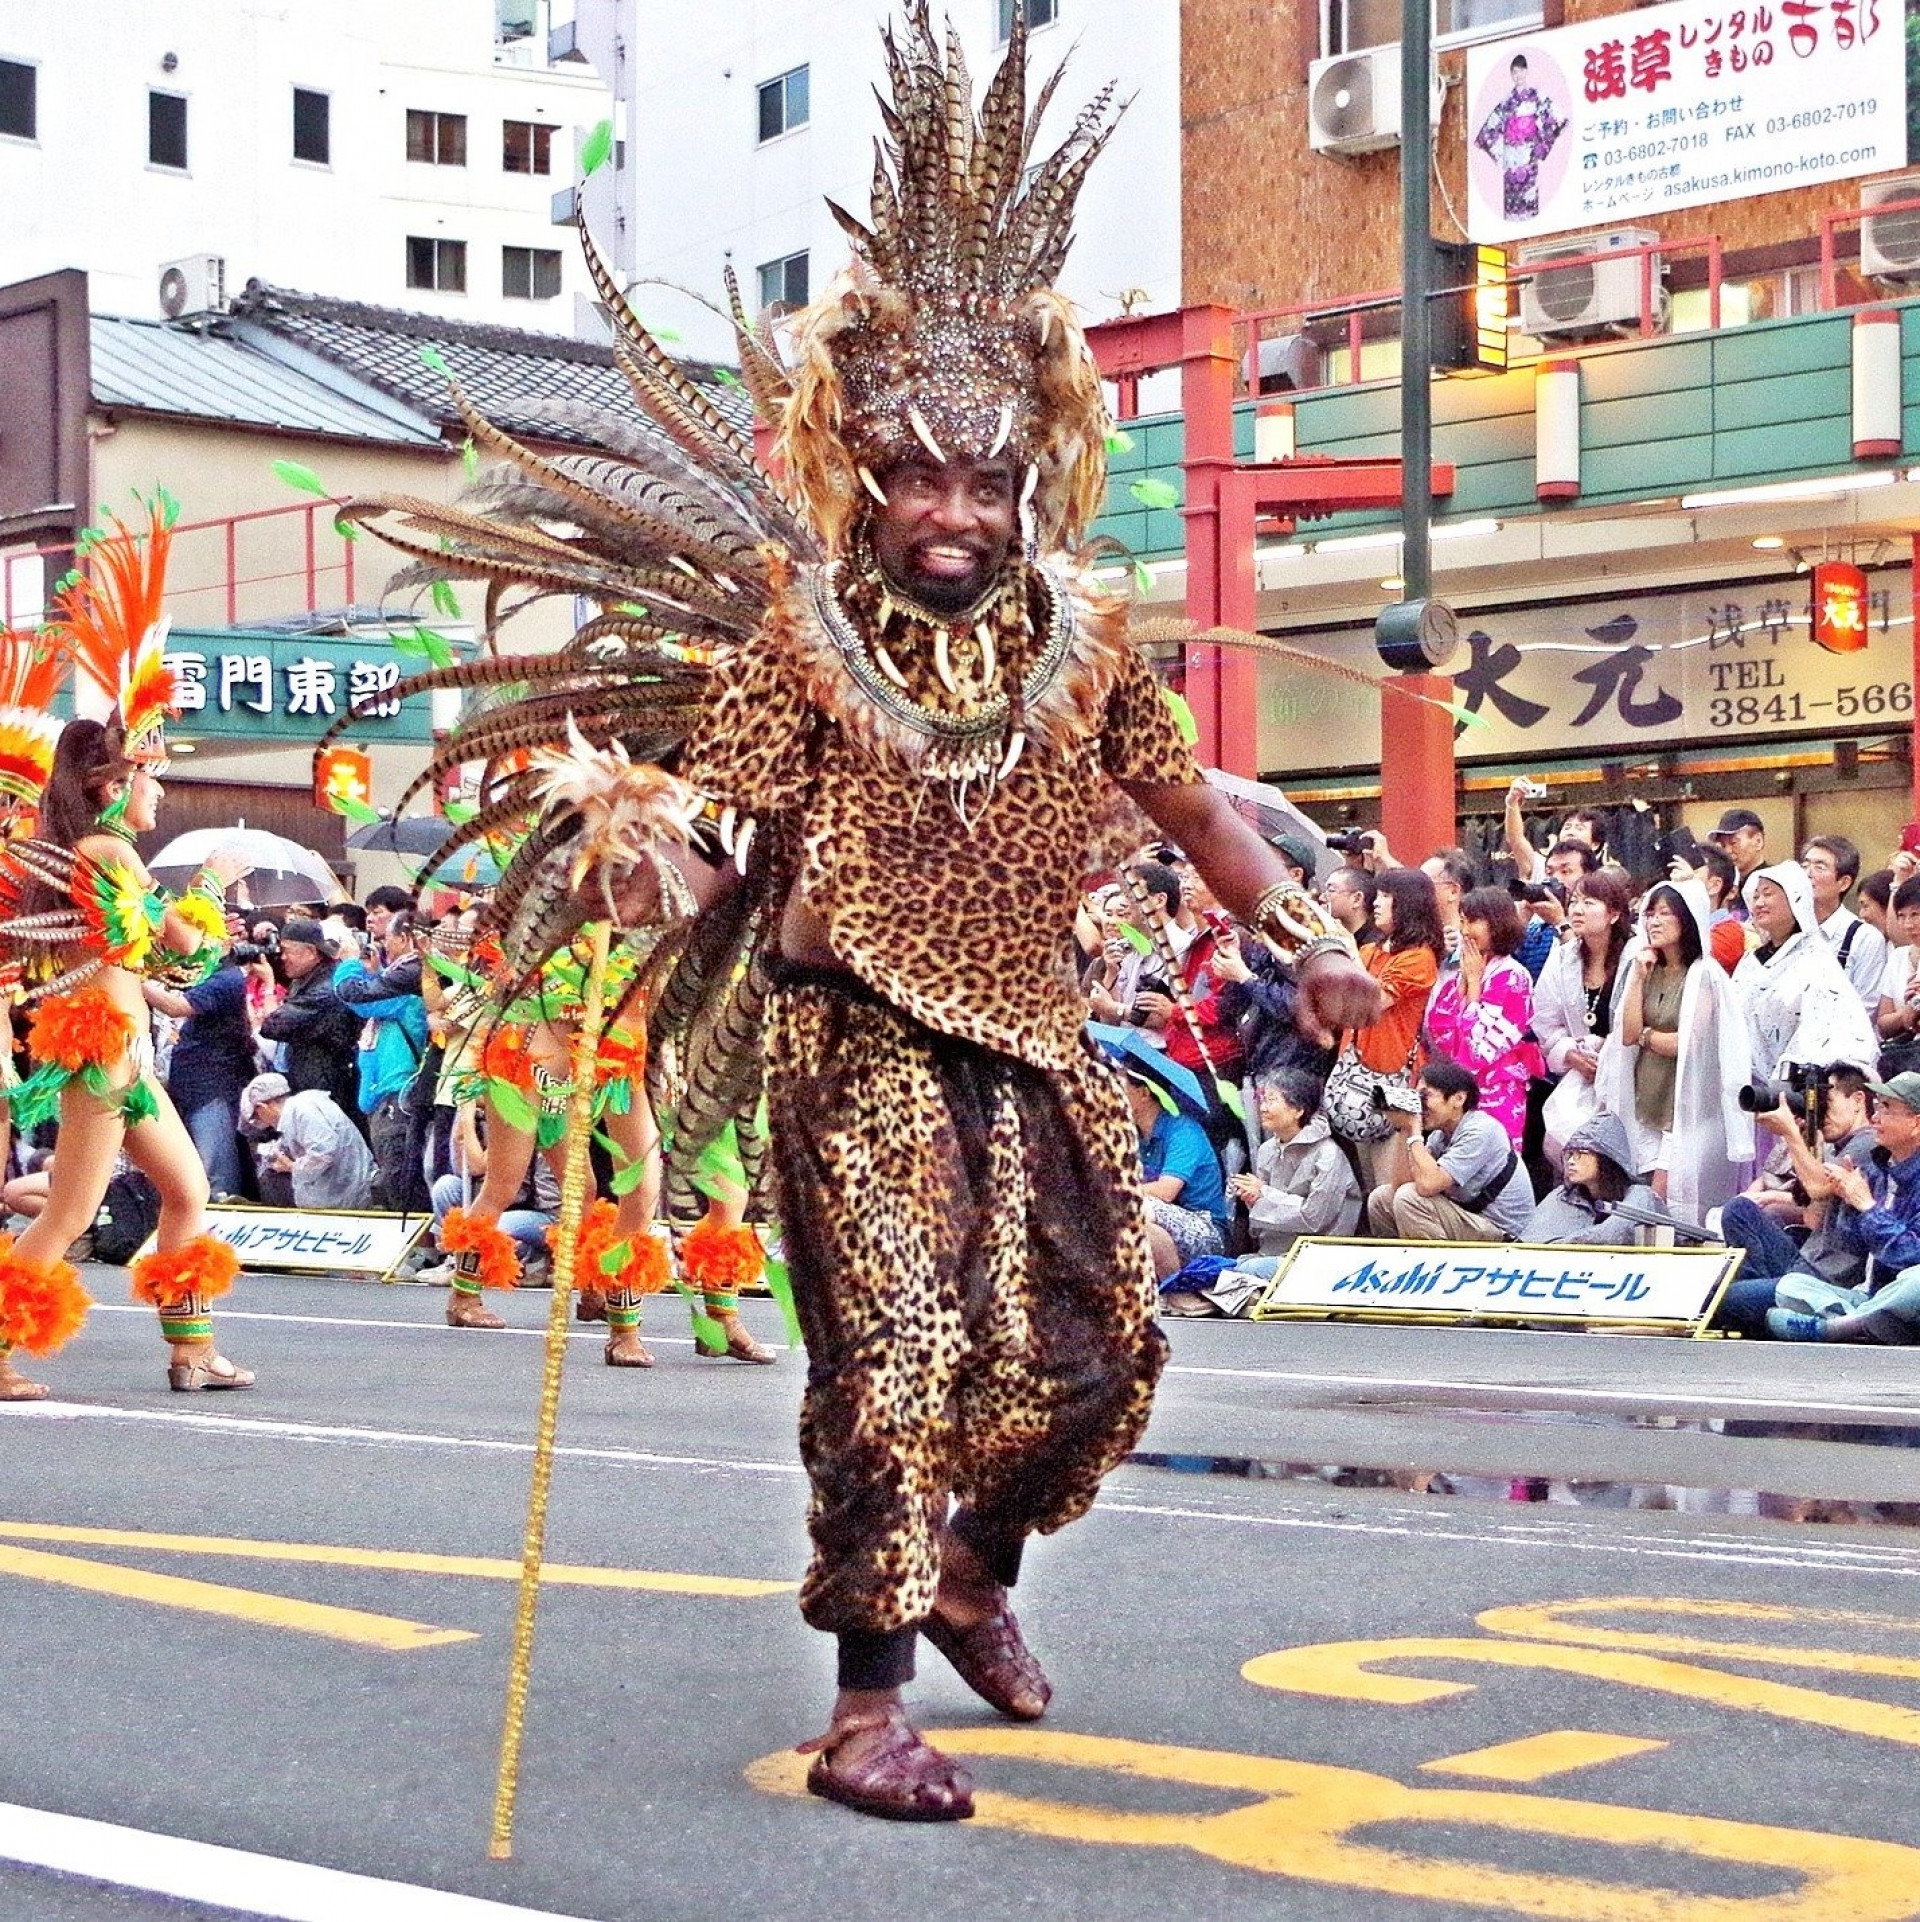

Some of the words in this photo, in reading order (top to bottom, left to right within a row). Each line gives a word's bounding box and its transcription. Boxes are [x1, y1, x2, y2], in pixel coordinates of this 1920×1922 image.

[1680, 5, 1773, 48] レンタル
[1583, 28, 1672, 103] 浅草
[1704, 40, 1774, 78] きもの
[1604, 132, 1708, 166] 03-6802-7018
[1725, 123, 1756, 142] FAX
[1766, 98, 1877, 134] 03-6802-7019
[1583, 186, 1655, 213] ホームページ
[1663, 145, 1877, 197] asakusa.kimono-koto.com
[1709, 659, 1785, 692] TEL
[249, 1227, 373, 1255] アサヒビール
[1331, 1260, 1448, 1295] Asahi
[1442, 1266, 1651, 1302] アサヒビール
